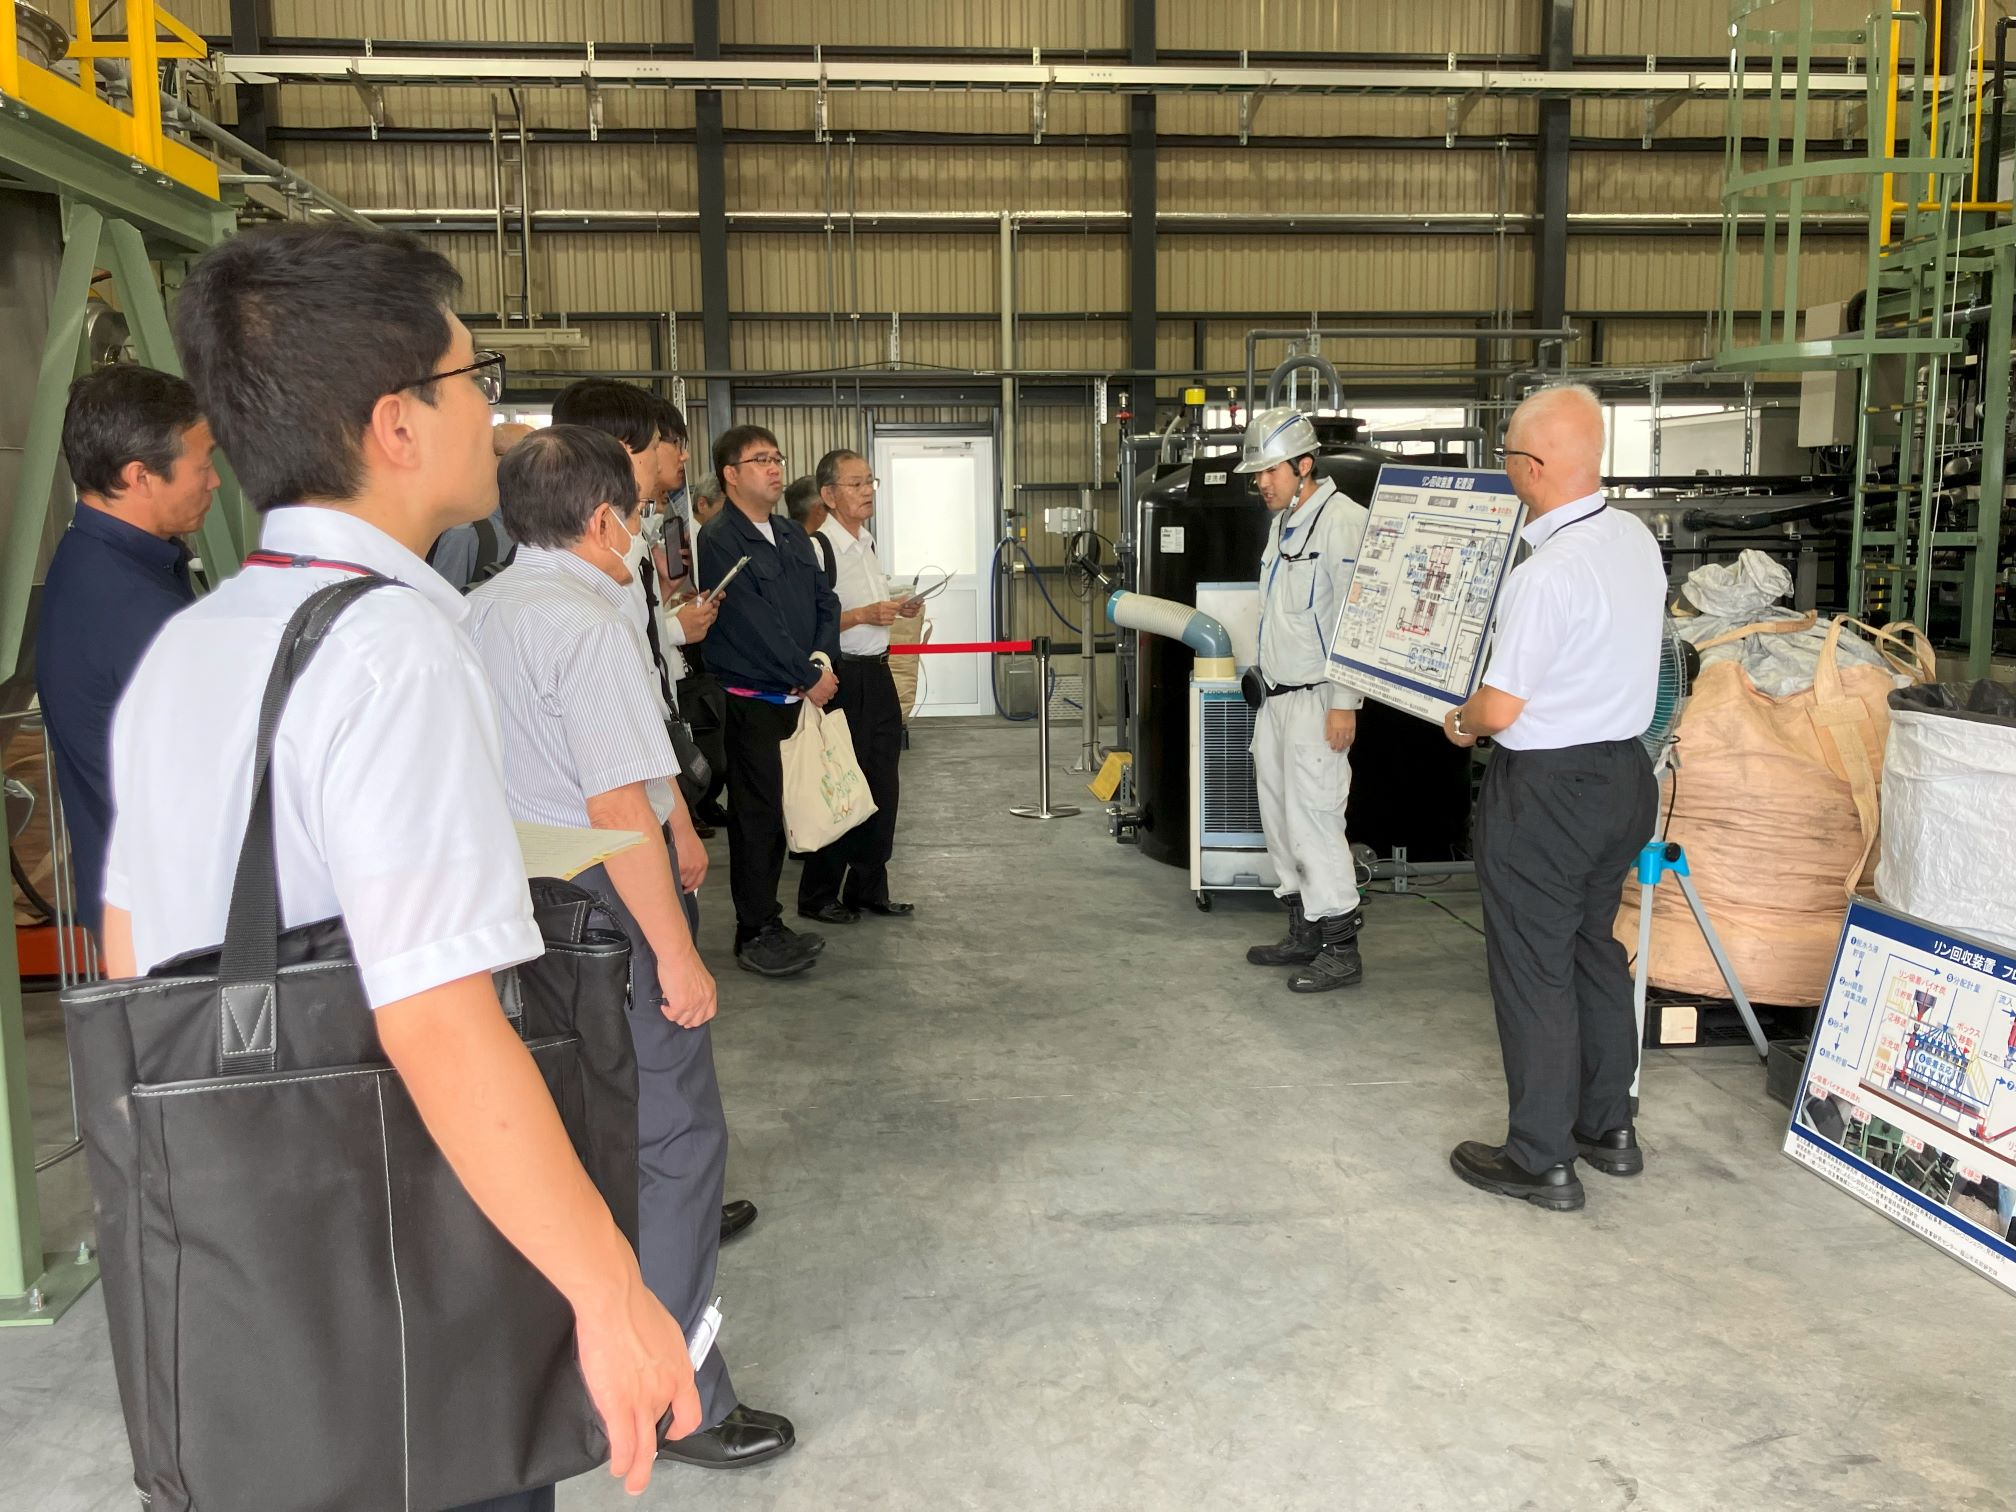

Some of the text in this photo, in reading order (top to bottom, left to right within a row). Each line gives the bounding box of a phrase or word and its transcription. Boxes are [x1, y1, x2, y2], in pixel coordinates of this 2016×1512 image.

[1933, 940, 1997, 975] リン回収装置
[1899, 969, 1947, 995] リン吸着バイオ炭
[1956, 1021, 1982, 1038] ボックス
[1958, 1034, 1973, 1047] 移動
